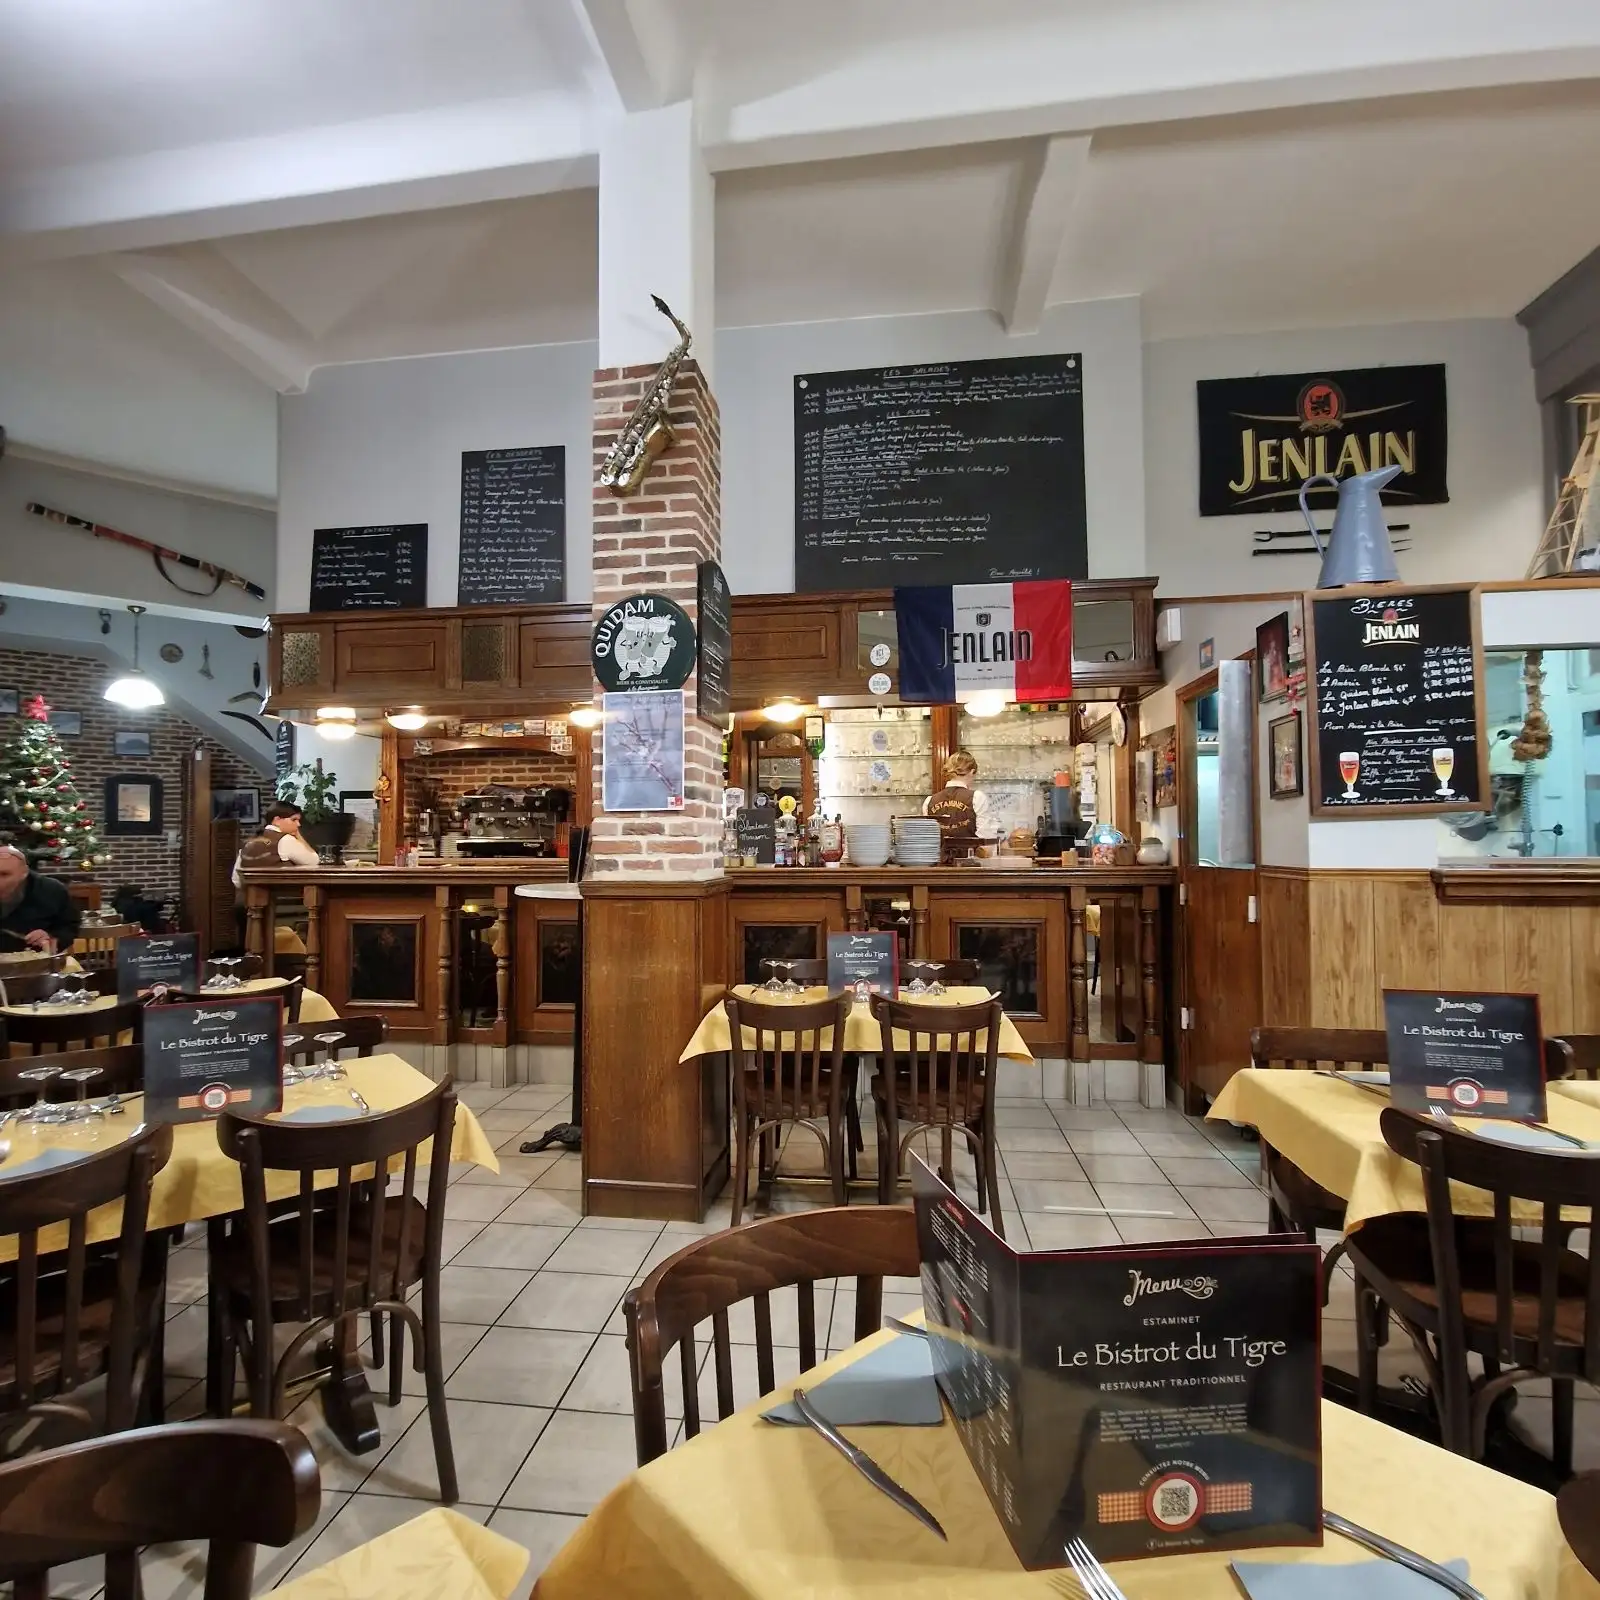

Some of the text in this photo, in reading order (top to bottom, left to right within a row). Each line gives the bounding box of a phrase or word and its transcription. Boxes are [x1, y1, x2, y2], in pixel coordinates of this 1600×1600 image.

[1229, 428, 1416, 493] JENLAIN
[595, 598, 655, 658] QUIDAM
[1362, 622, 1420, 644] JENLAIN
[937, 627, 1032, 669] JENLAIN
[1359, 664, 1391, 672] Blonde
[161, 1032, 269, 1050] Le Bistrot du Tigre
[1403, 1025, 1525, 1043] Le Bistrot du Tigre
[1123, 1269, 1184, 1307] Menu
[1143, 1315, 1201, 1326] ESTAMINET
[1057, 1331, 1288, 1367] Le Bistrot du Tigre
[1100, 1374, 1247, 1392] RESTAURANT TRADITIONNEL
[1139, 1460, 1171, 1486] CONSULTEZ
